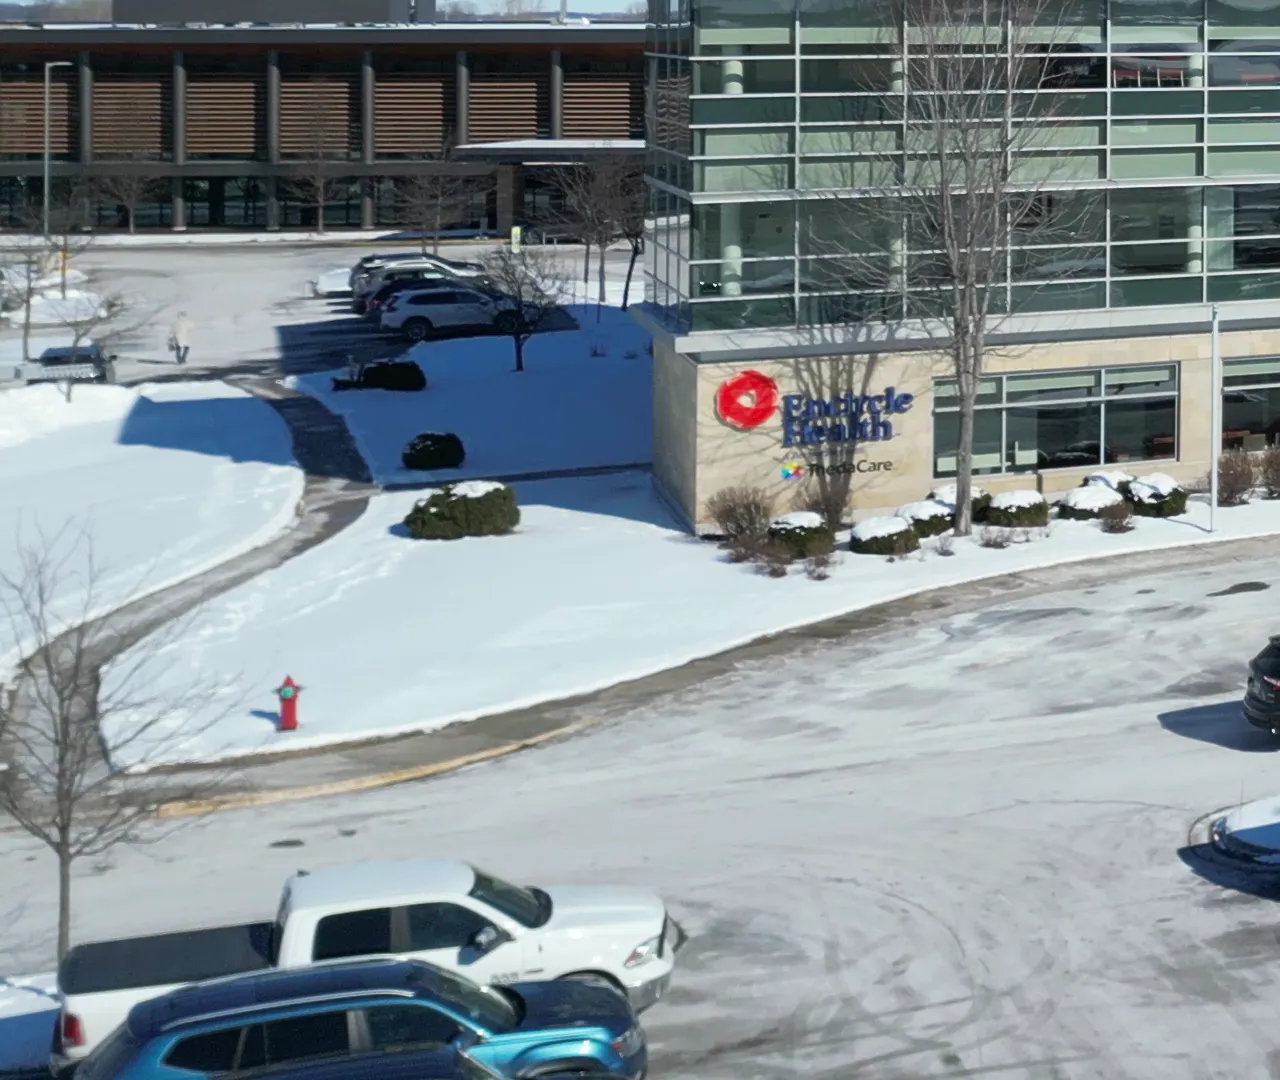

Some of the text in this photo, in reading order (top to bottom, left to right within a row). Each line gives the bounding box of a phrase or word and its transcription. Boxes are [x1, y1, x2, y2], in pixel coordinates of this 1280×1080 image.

[781, 386, 914, 418] Encircle
[781, 411, 893, 448] Health
[808, 459, 893, 477] ThedaCare
